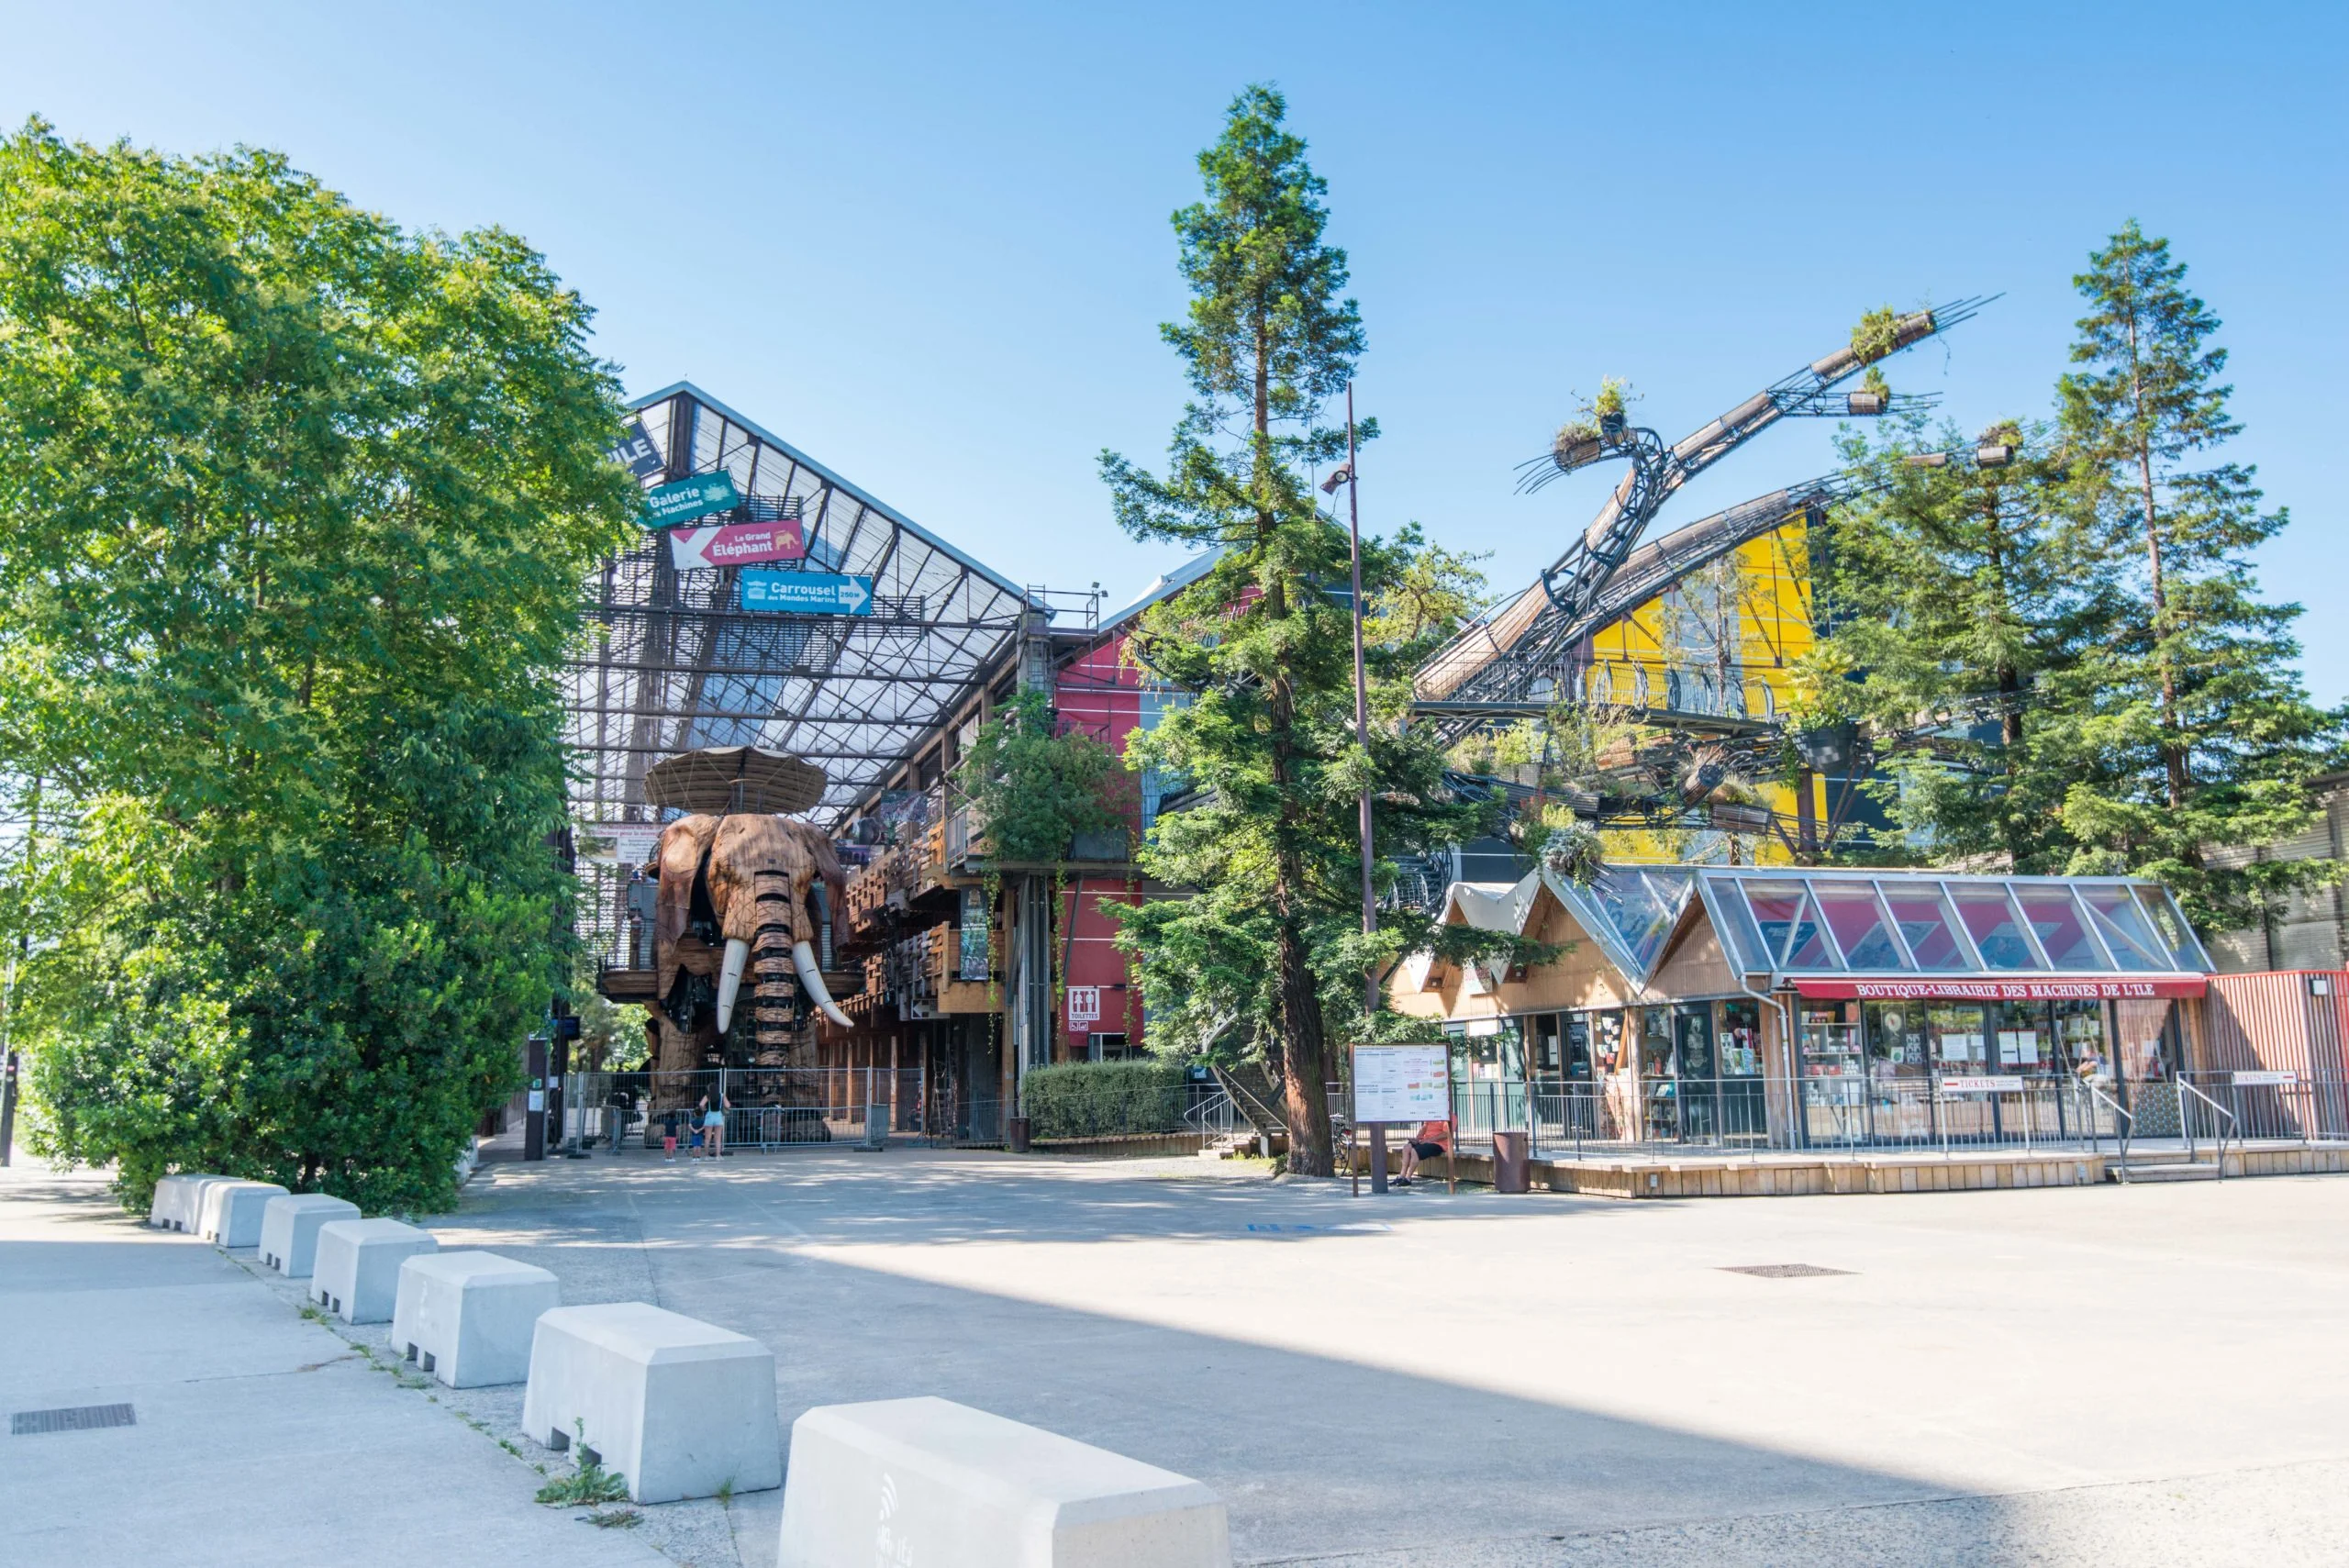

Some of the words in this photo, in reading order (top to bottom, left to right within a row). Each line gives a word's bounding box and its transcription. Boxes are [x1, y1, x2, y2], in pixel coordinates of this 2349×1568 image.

[650, 487, 700, 508] Galerie
[662, 499, 704, 516] Machines
[746, 532, 771, 541] Grand
[712, 540, 773, 557] Éléphant
[771, 582, 836, 595] Carrousel
[780, 594, 808, 602] Mondes
[1855, 984, 1998, 998] BOUTIQUE-LIBRAIRIE
[2001, 984, 2026, 997] DES
[2029, 984, 2098, 997] MACHINES
[2100, 984, 2120, 996] DE
[2123, 984, 2154, 996] L'ILE
[1960, 1079, 1996, 1087] TICKETS
